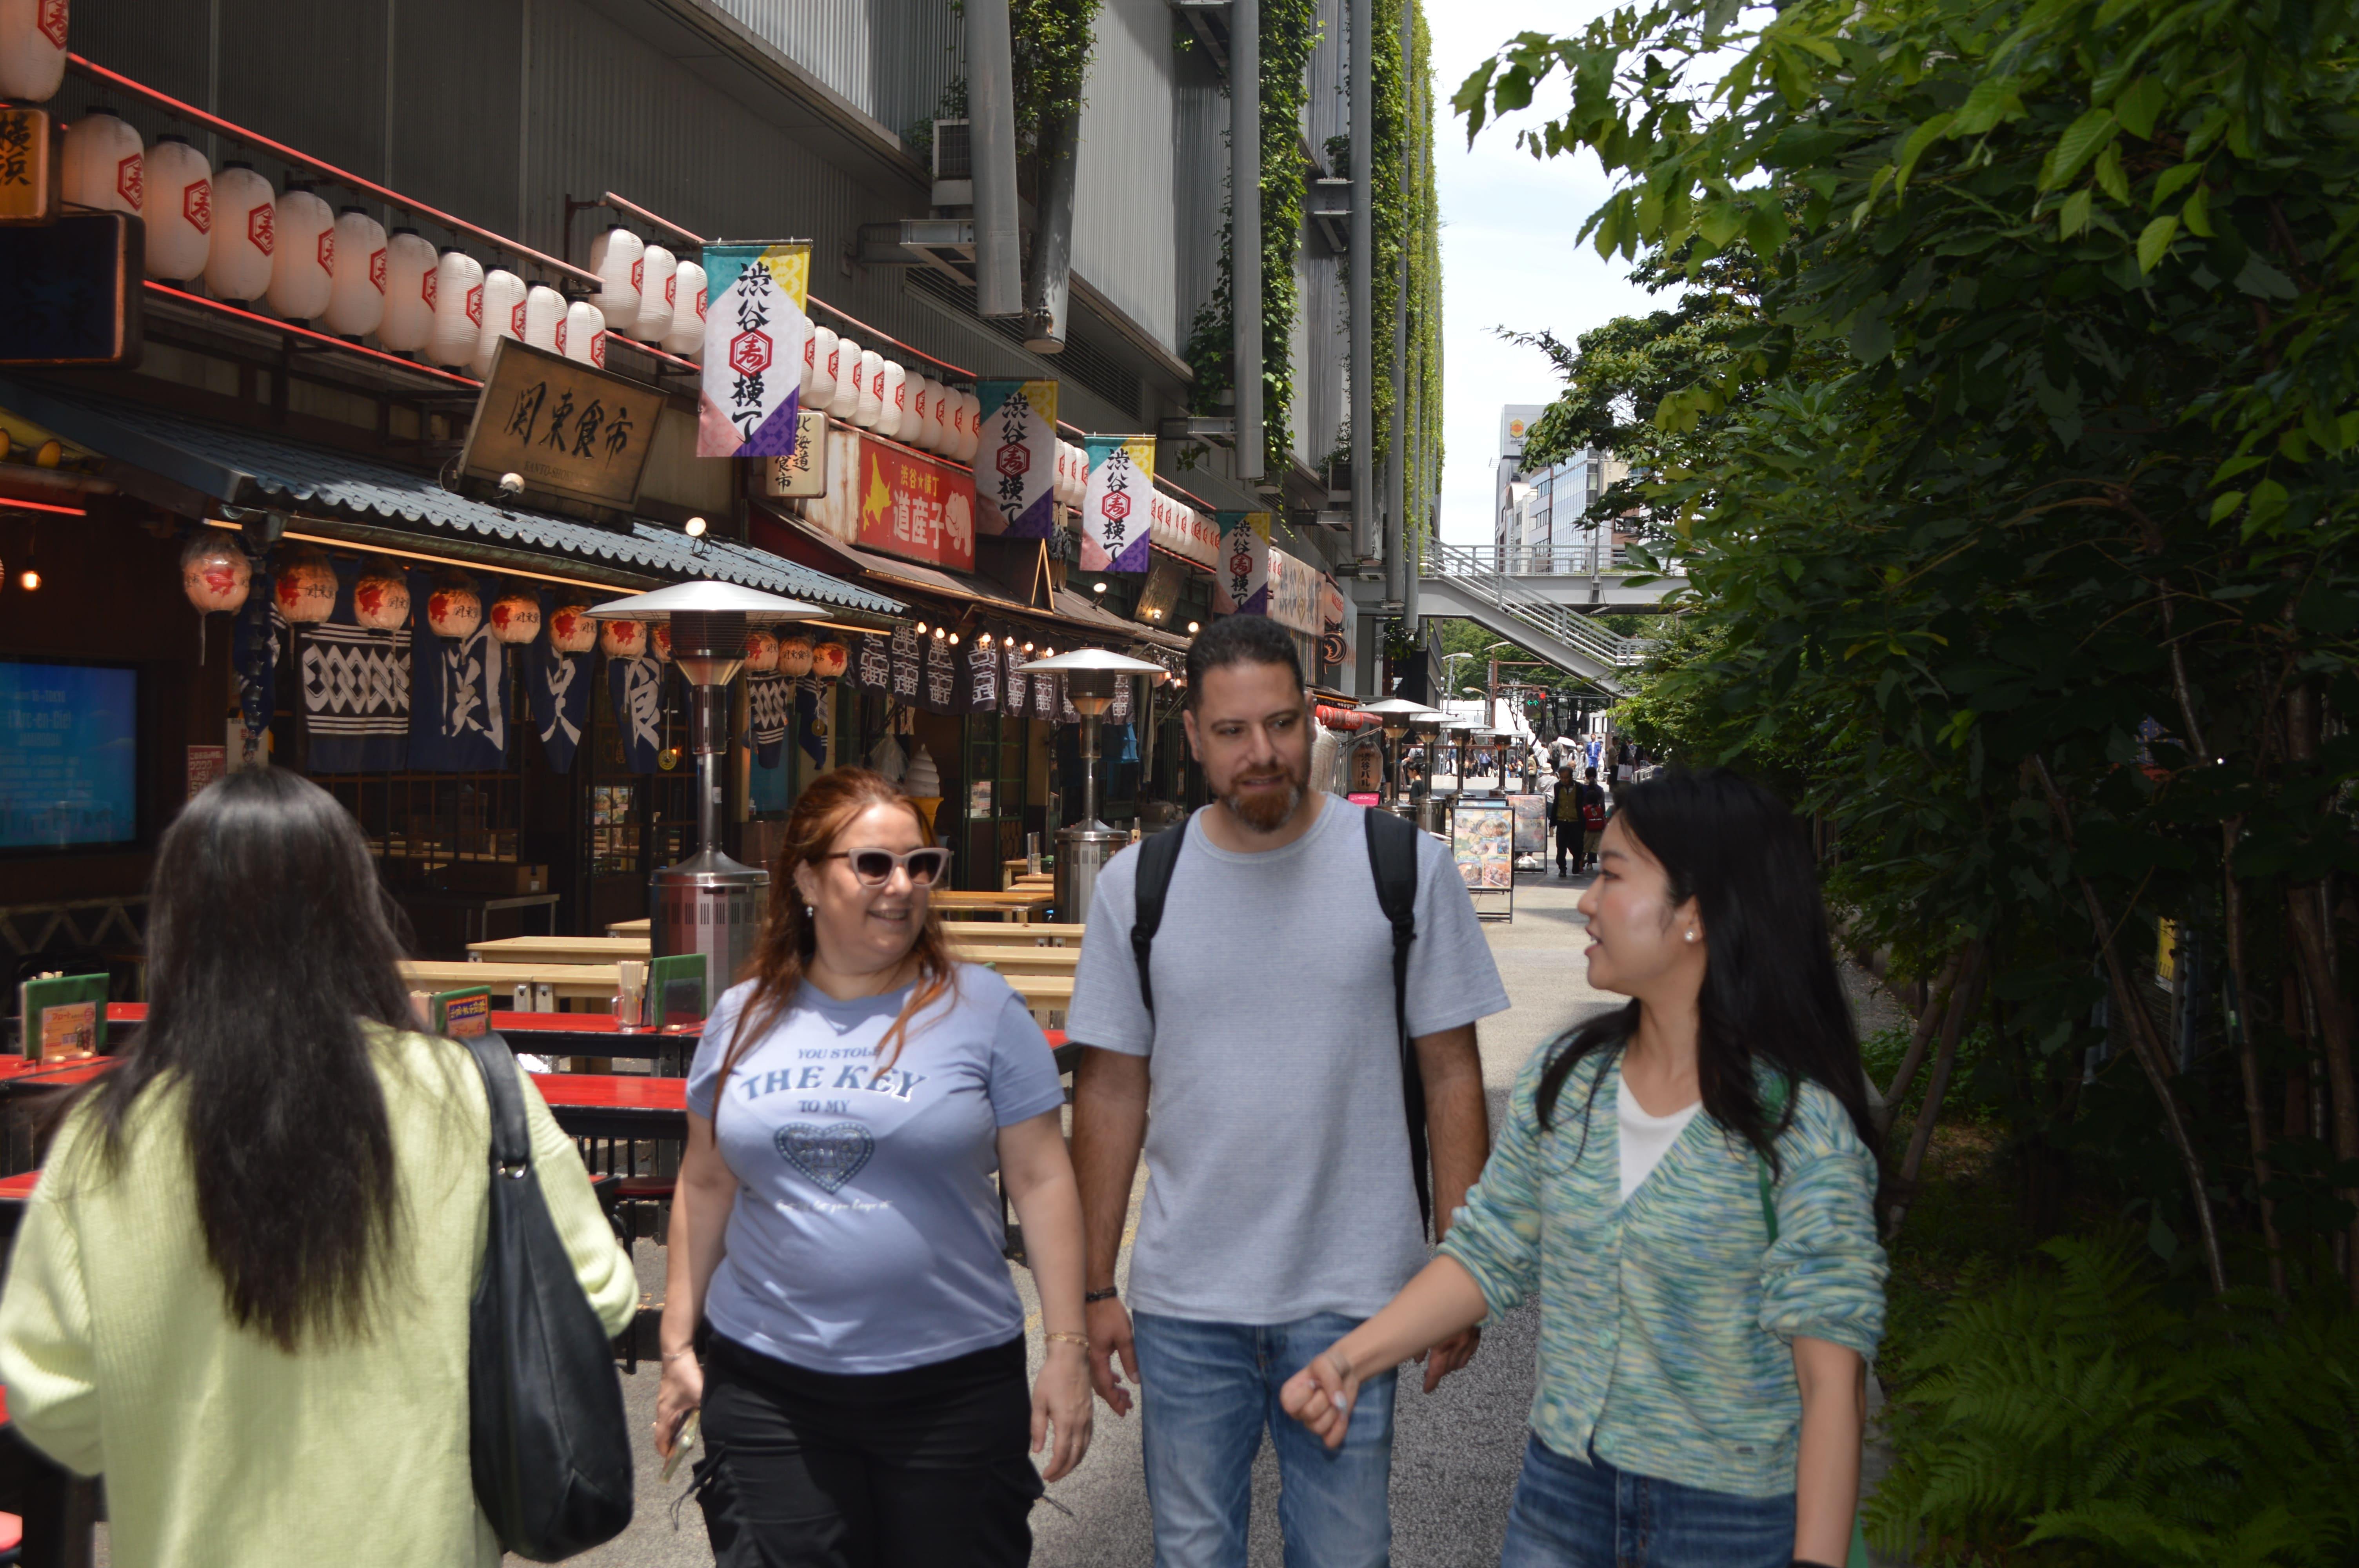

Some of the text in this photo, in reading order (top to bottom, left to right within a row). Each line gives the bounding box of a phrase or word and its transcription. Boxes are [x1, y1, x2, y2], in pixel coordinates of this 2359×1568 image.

[504, 381, 633, 470] 関東食市
[893, 490, 945, 549] 道産子
[798, 1048, 827, 1059] YOU
[741, 1065, 927, 1100] THE KEY
[798, 1100, 849, 1113] TO MY
